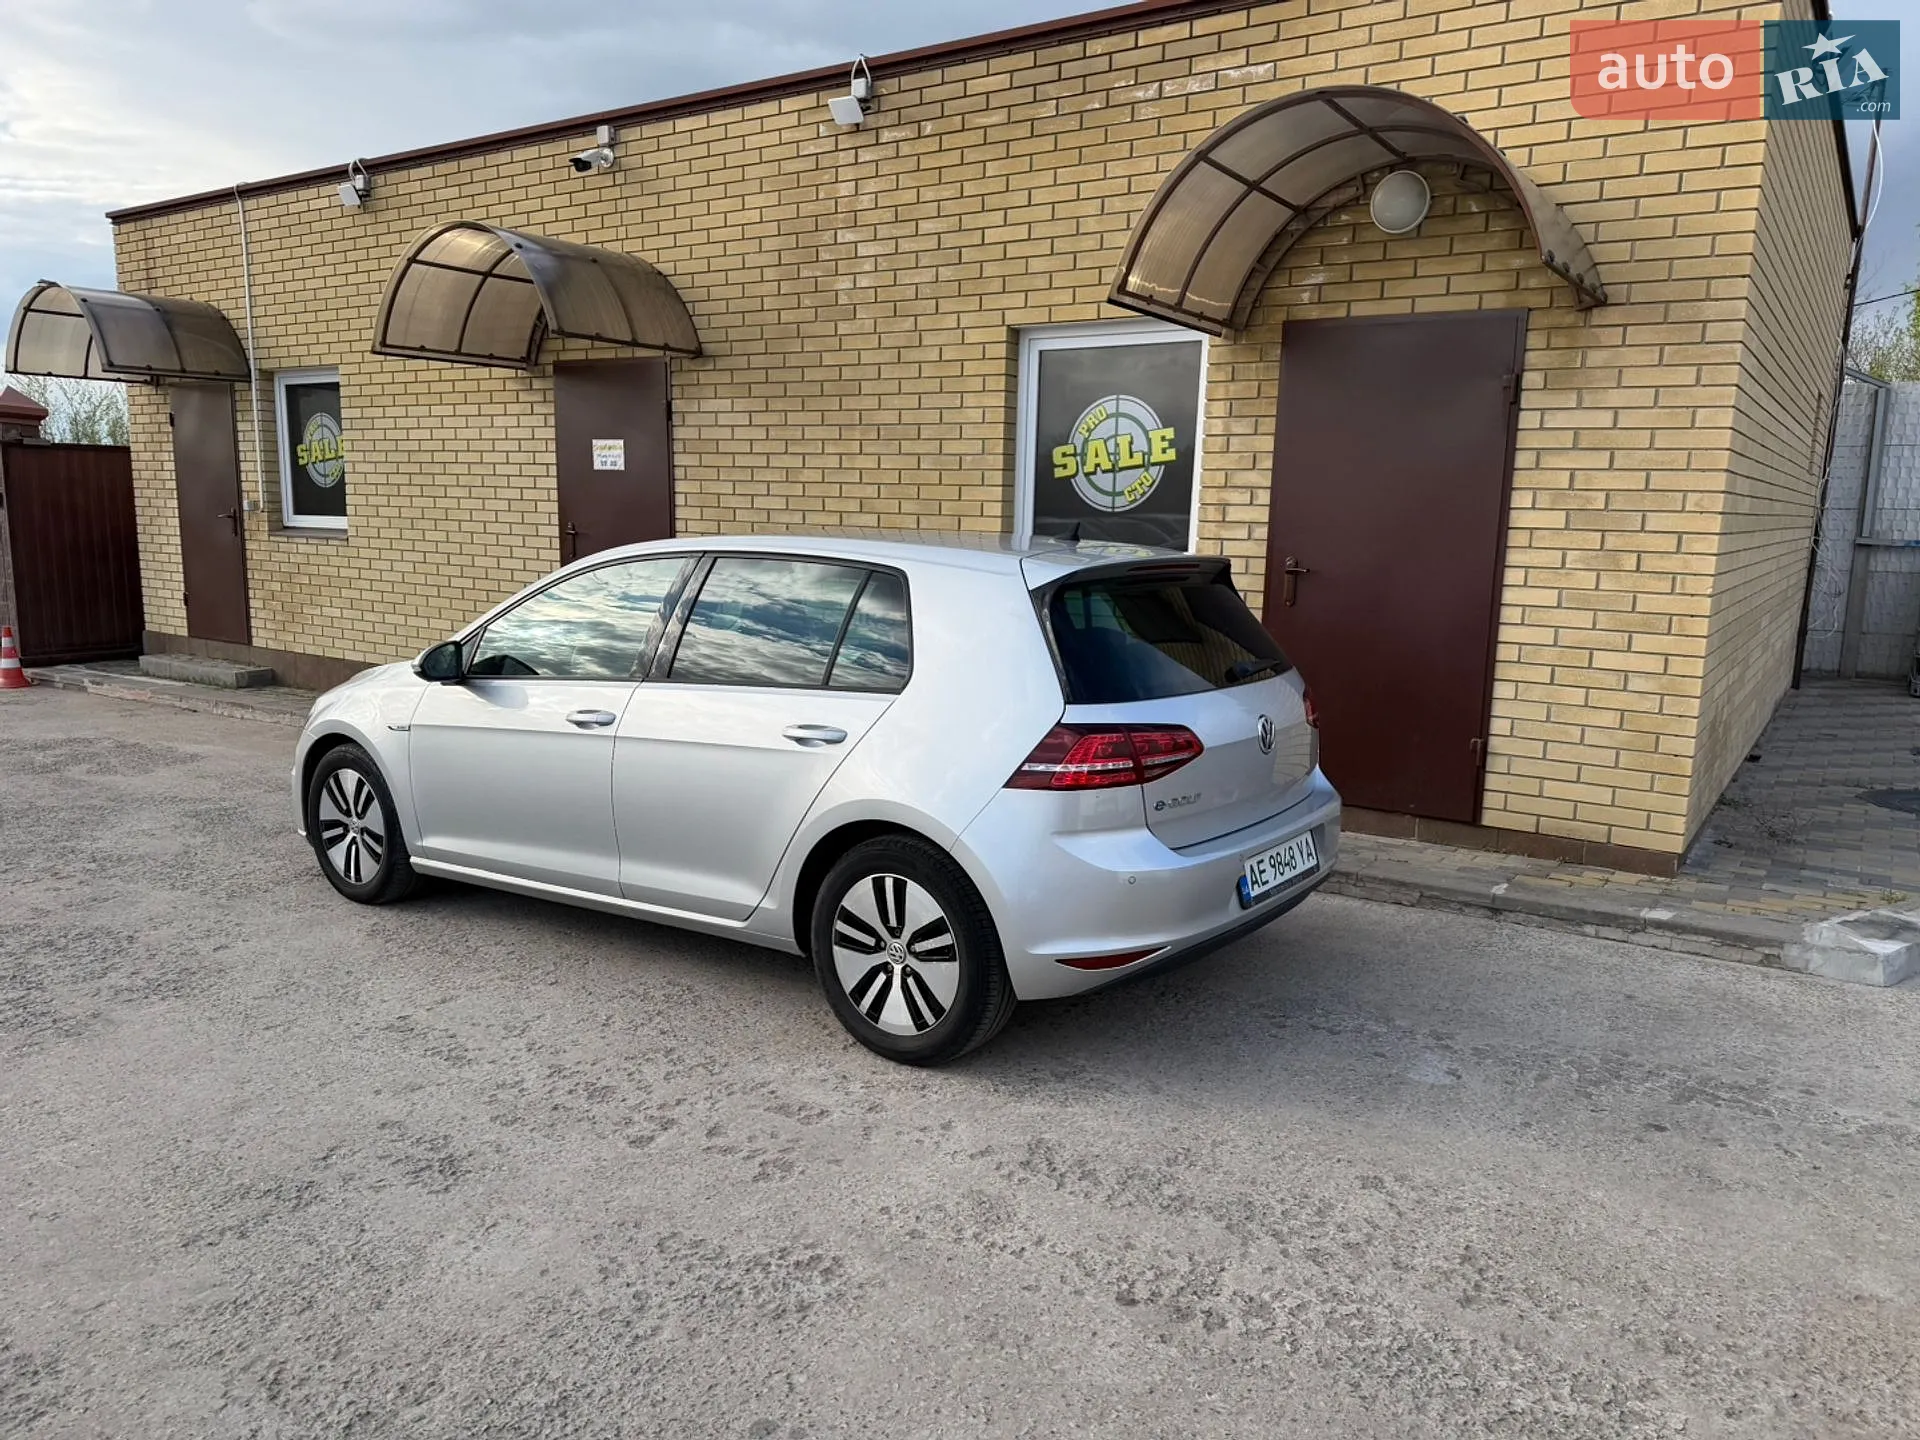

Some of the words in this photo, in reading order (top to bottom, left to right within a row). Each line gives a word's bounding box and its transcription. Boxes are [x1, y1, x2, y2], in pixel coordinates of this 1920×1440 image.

[1078, 404, 1108, 439] PRO
[1053, 427, 1176, 479] SALE
[1249, 858, 1269, 892] AE
[1268, 845, 1298, 881] 9848
[1296, 836, 1316, 866] YA
